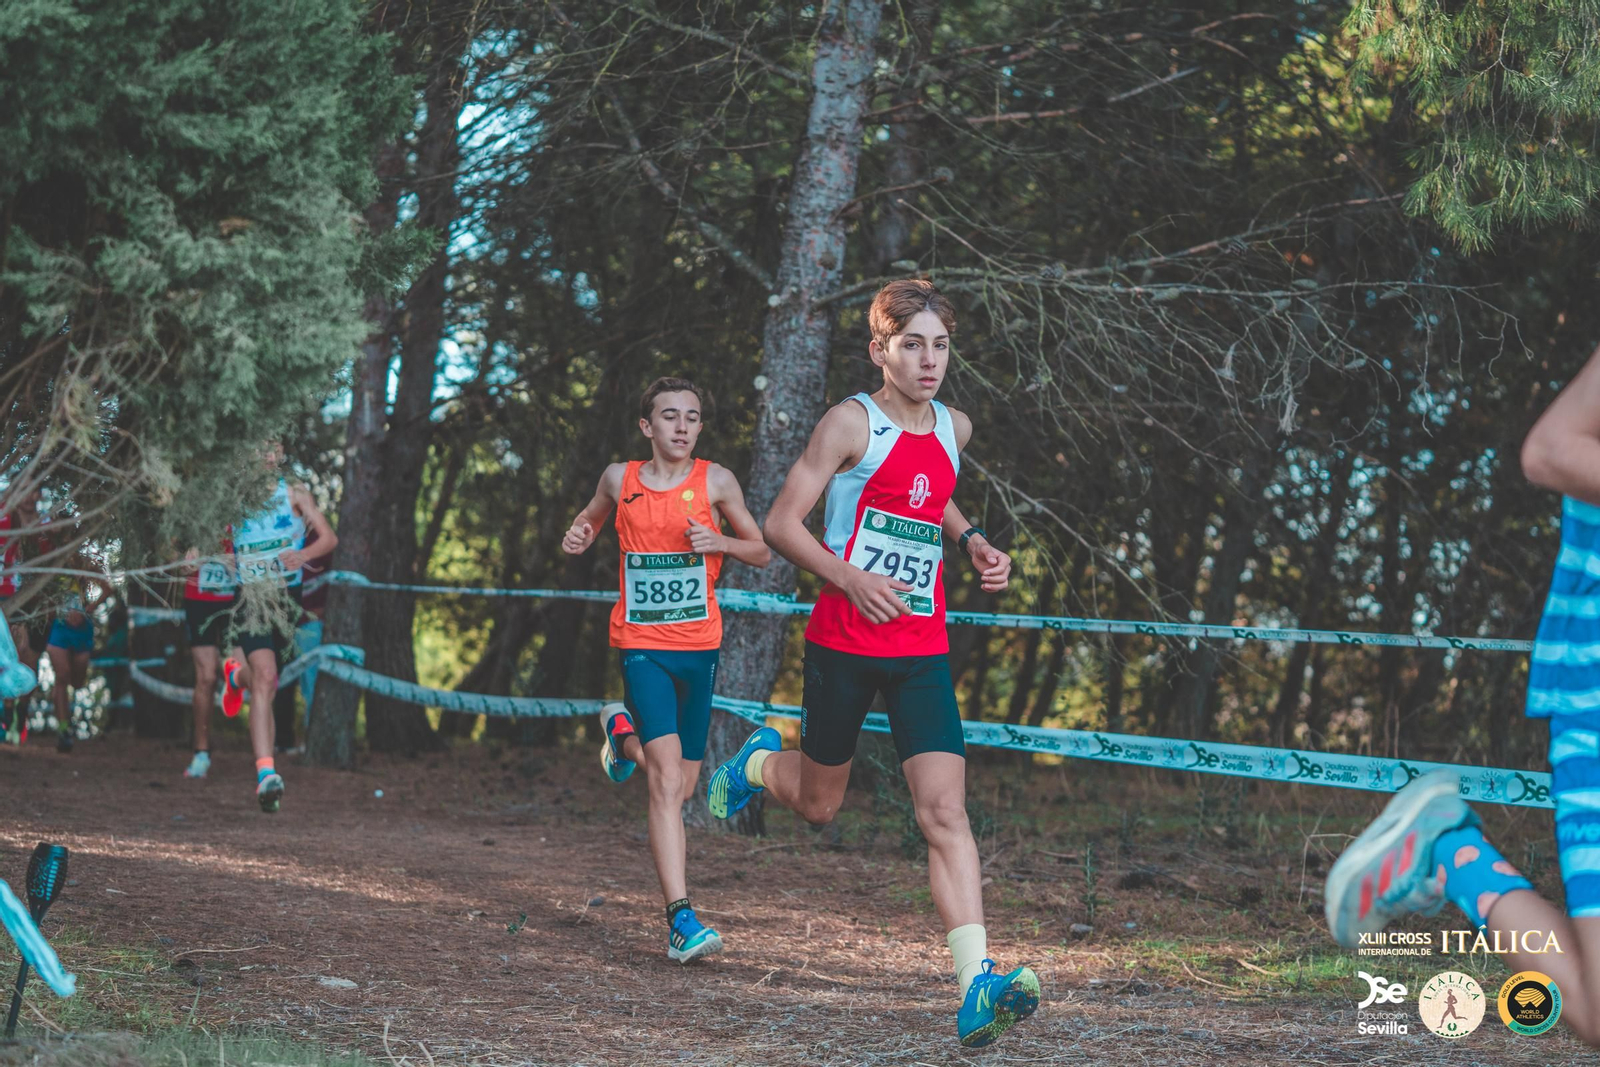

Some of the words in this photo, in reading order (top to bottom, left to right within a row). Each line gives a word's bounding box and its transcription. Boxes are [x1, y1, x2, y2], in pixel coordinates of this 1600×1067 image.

[891, 520, 930, 538] ITÁLICA
[246, 556, 287, 578] 594
[645, 554, 685, 566] ITÁLICA
[862, 545, 933, 589] 7953
[634, 578, 702, 604] 5882
[1220, 759, 1254, 773] Sevilla
[1323, 769, 1359, 784] Sevilla
